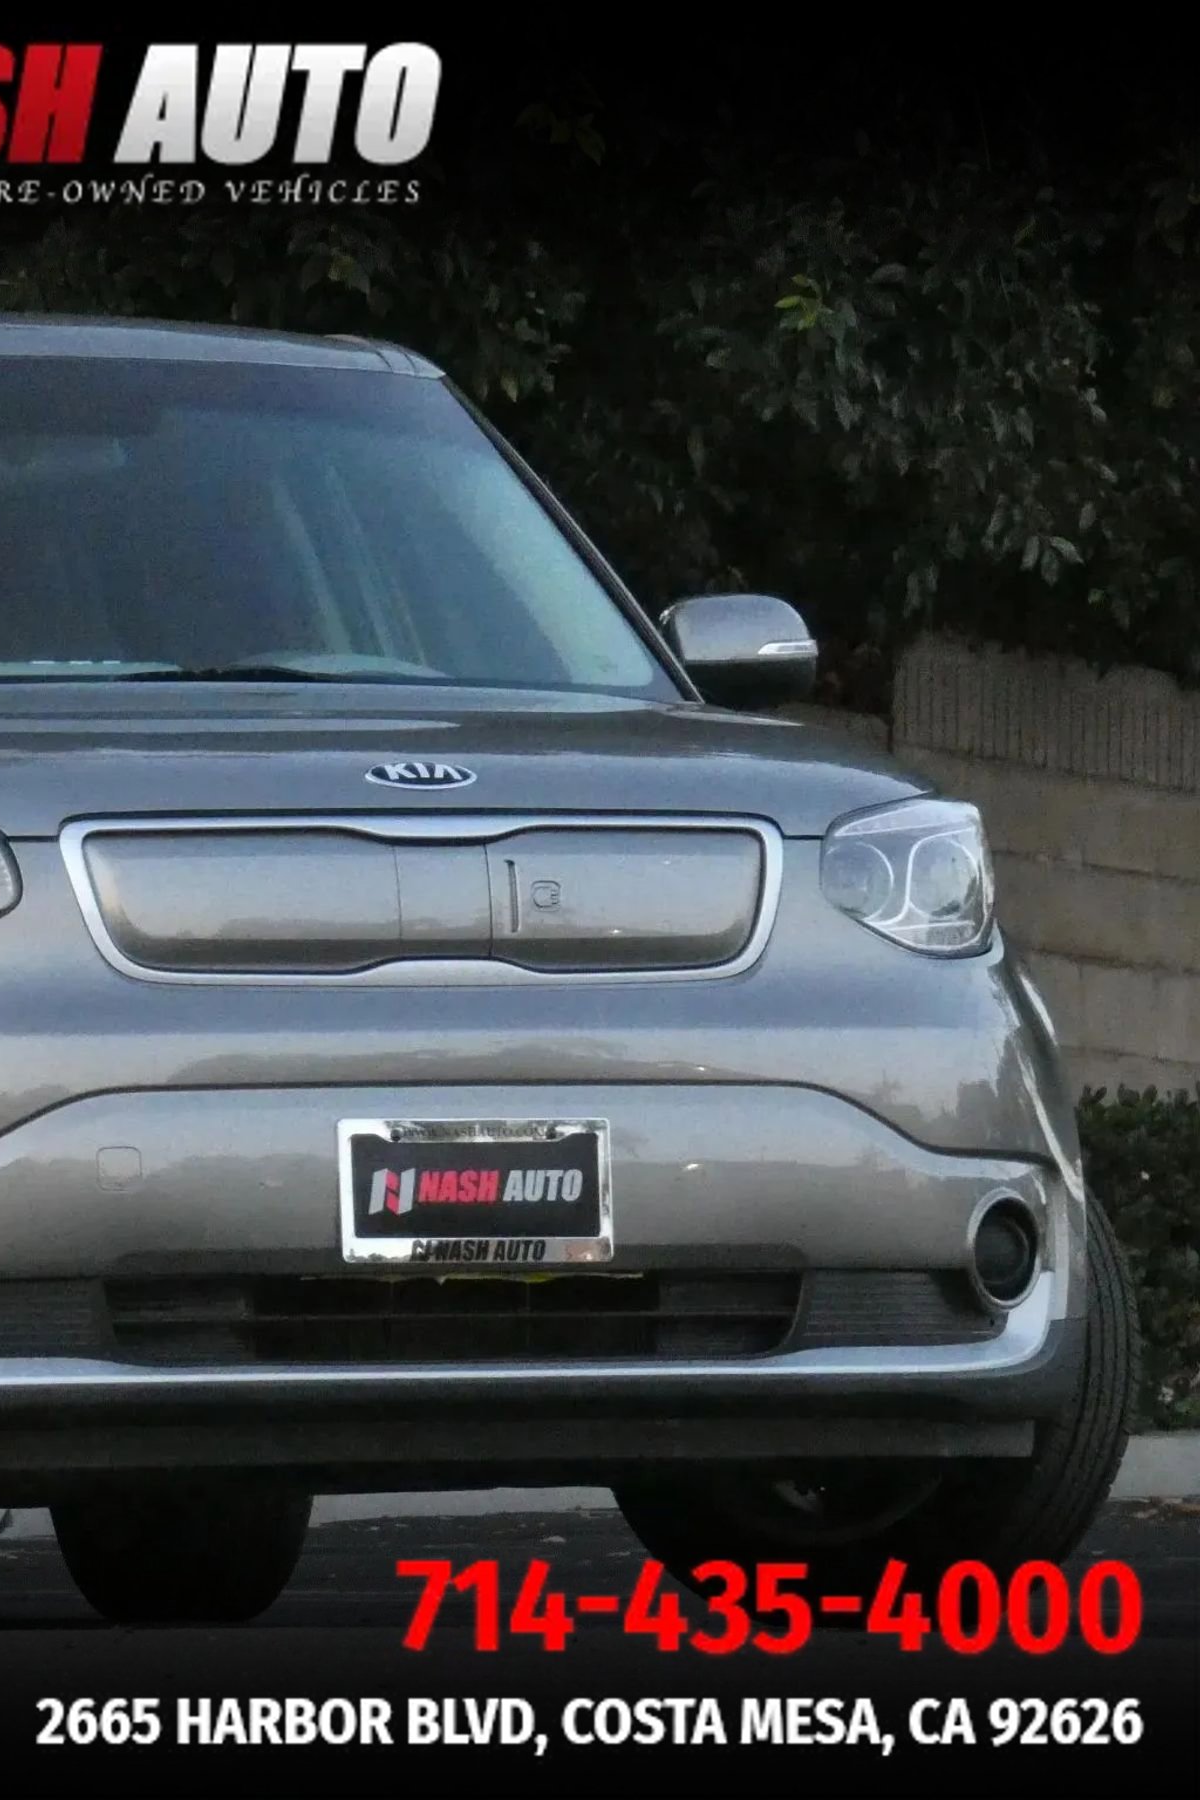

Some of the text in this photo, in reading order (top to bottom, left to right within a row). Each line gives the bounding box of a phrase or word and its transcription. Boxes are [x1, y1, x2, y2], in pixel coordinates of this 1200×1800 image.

[383, 762, 463, 781] KIA
[418, 1169, 499, 1204] NASH
[502, 1168, 583, 1202] AUTO
[434, 1239, 490, 1262] NASH
[493, 1239, 546, 1262] AUTO
